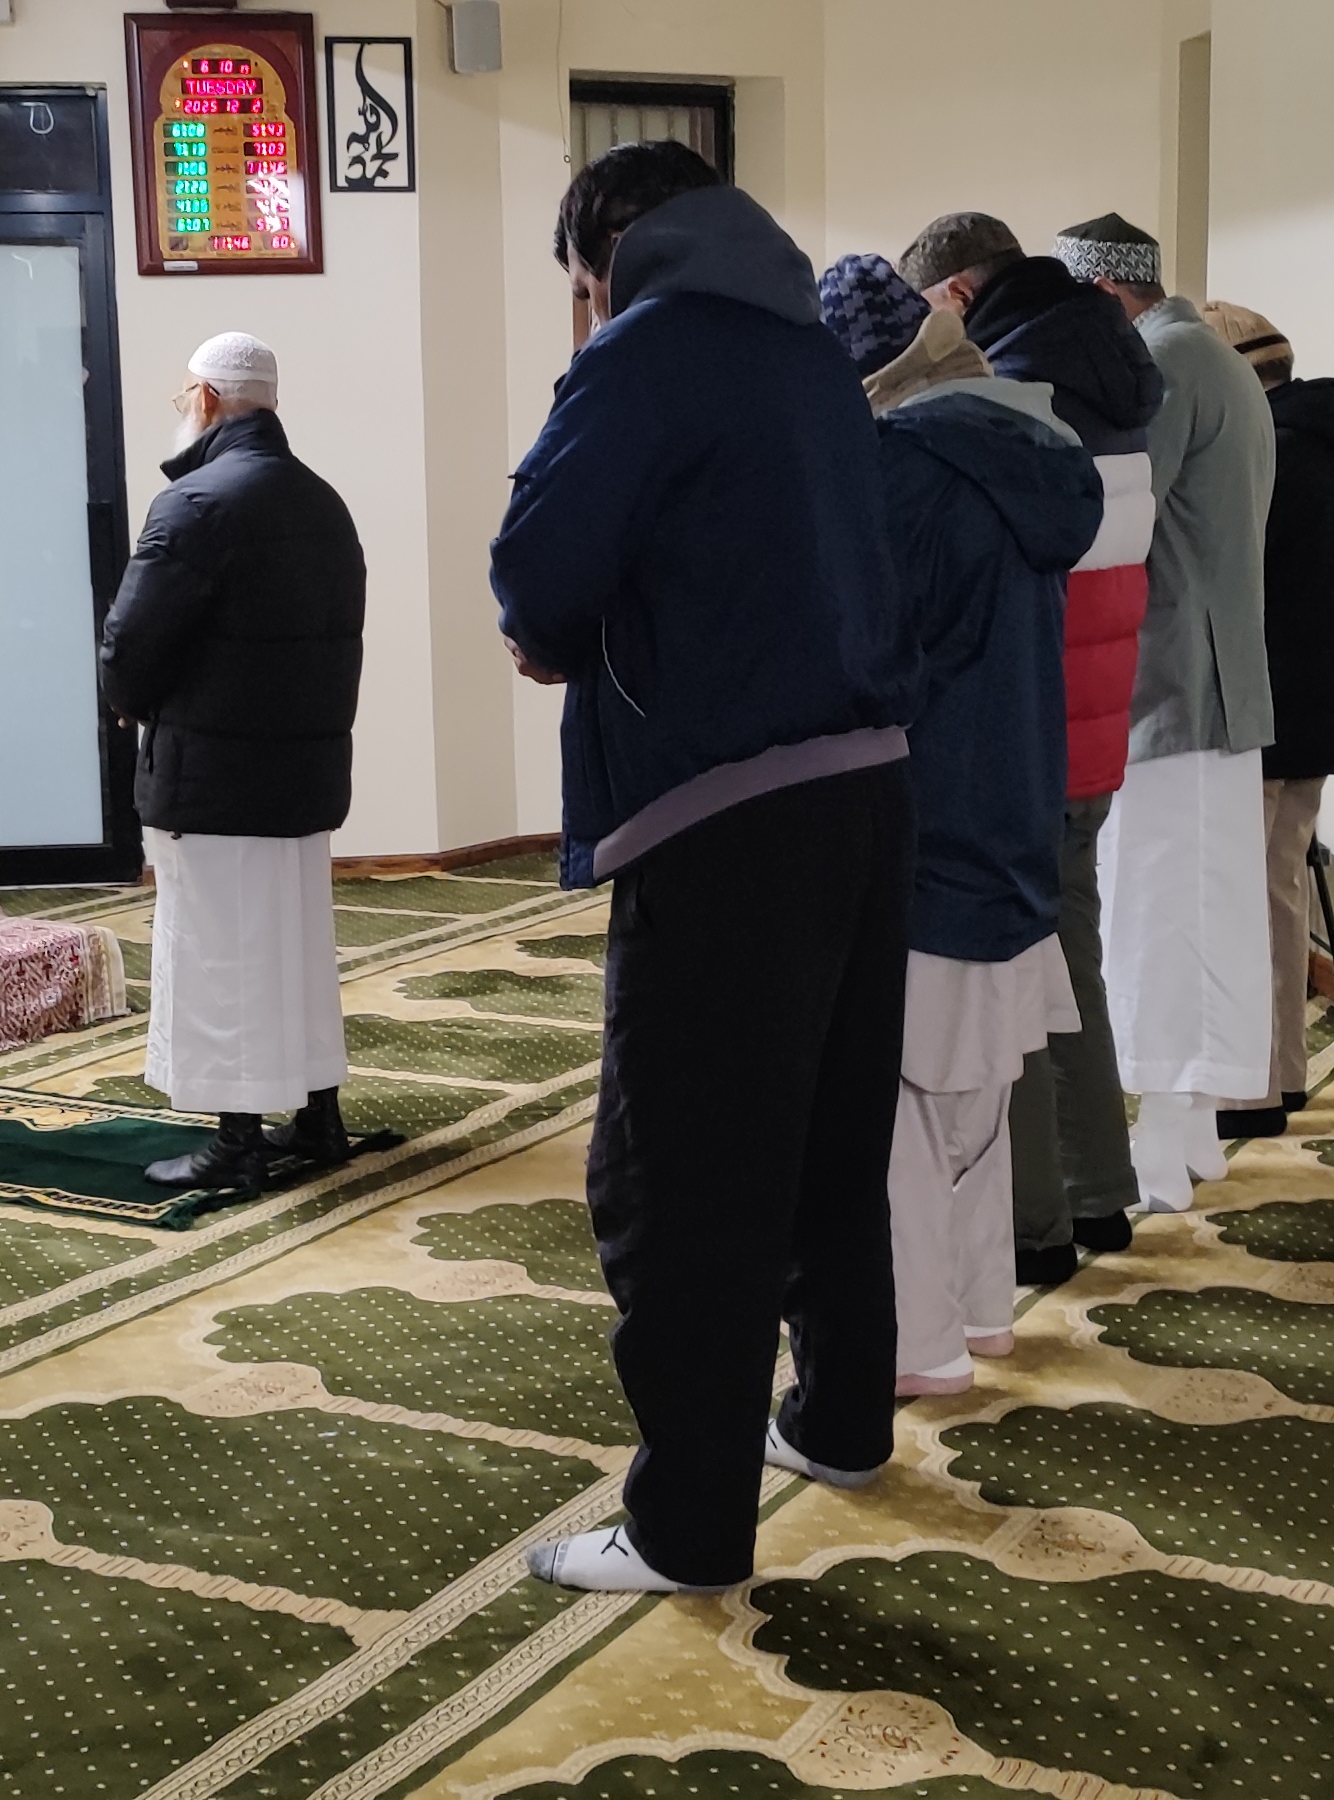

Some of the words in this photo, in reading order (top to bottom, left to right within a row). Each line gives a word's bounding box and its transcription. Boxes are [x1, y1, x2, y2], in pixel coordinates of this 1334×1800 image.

[185, 79, 257, 95] TUESDAY
[184, 99, 218, 113] 2025
[226, 99, 239, 113] 12
[253, 142, 285, 155] 7:03
